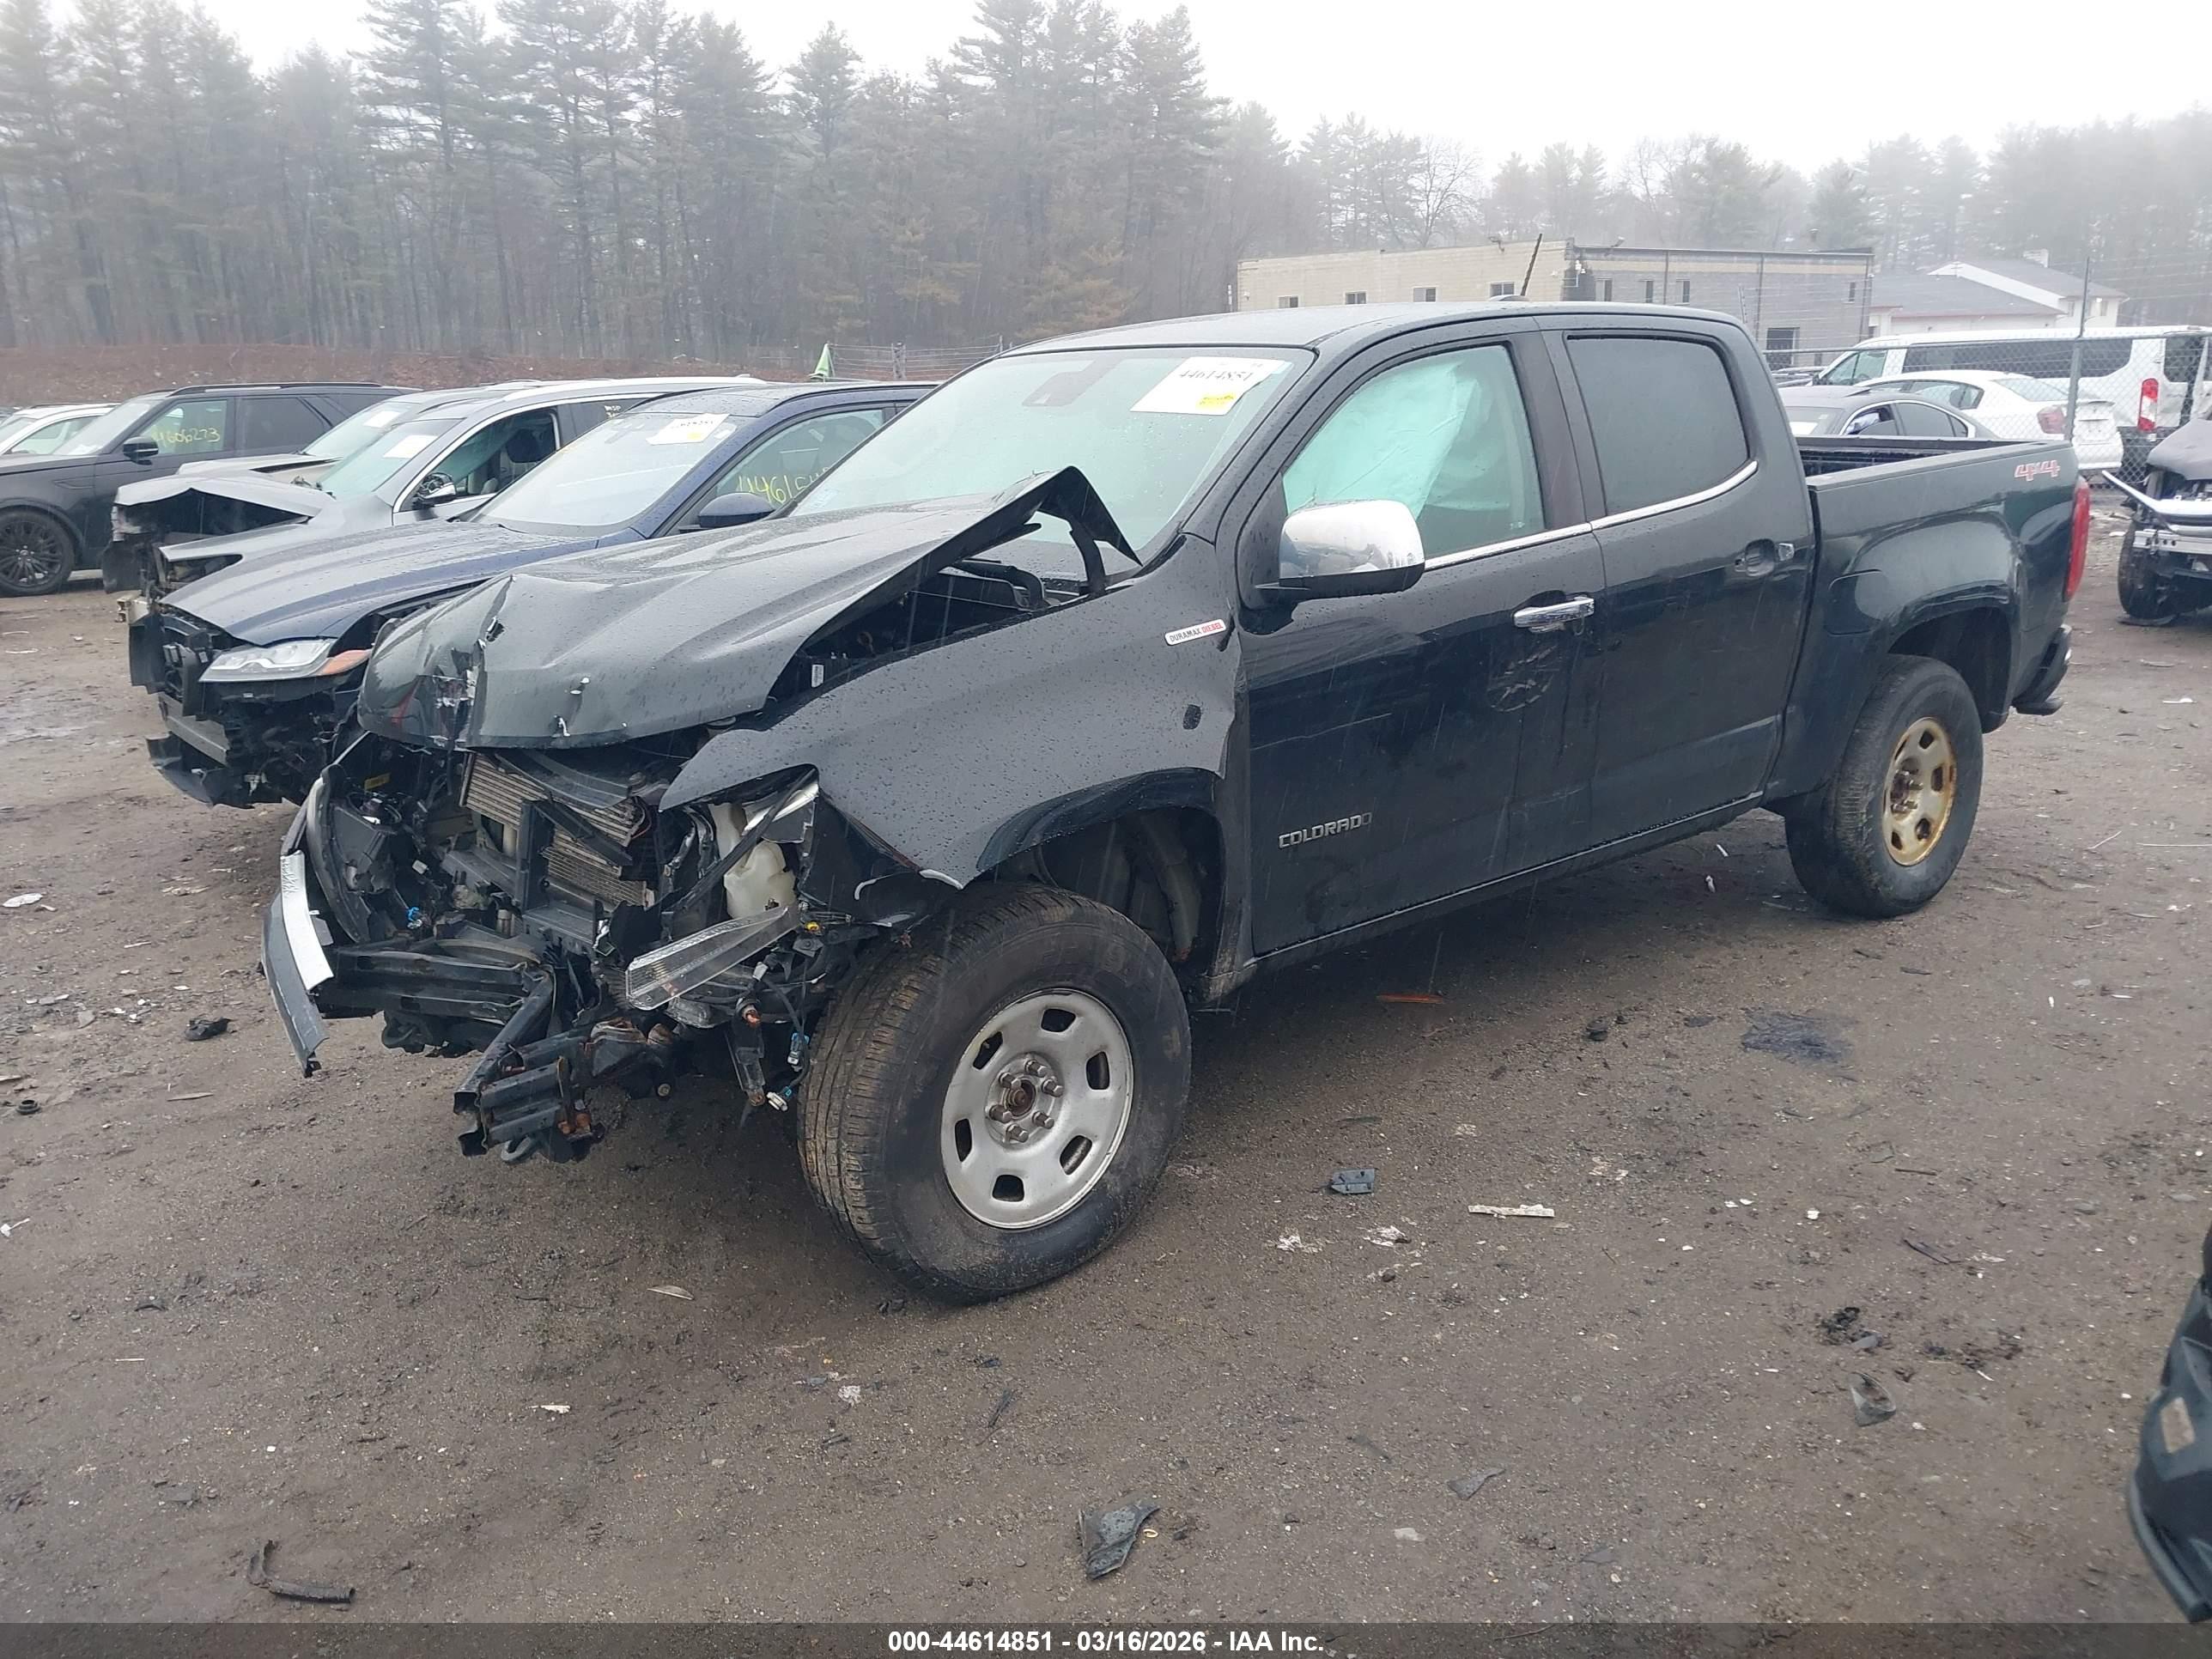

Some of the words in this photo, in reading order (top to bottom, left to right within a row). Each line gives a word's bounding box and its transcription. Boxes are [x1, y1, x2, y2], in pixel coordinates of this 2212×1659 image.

[1170, 629, 1201, 642] DURAMAX
[1202, 623, 1224, 633] DIESEL
[1279, 811, 1372, 848] COLORADO
